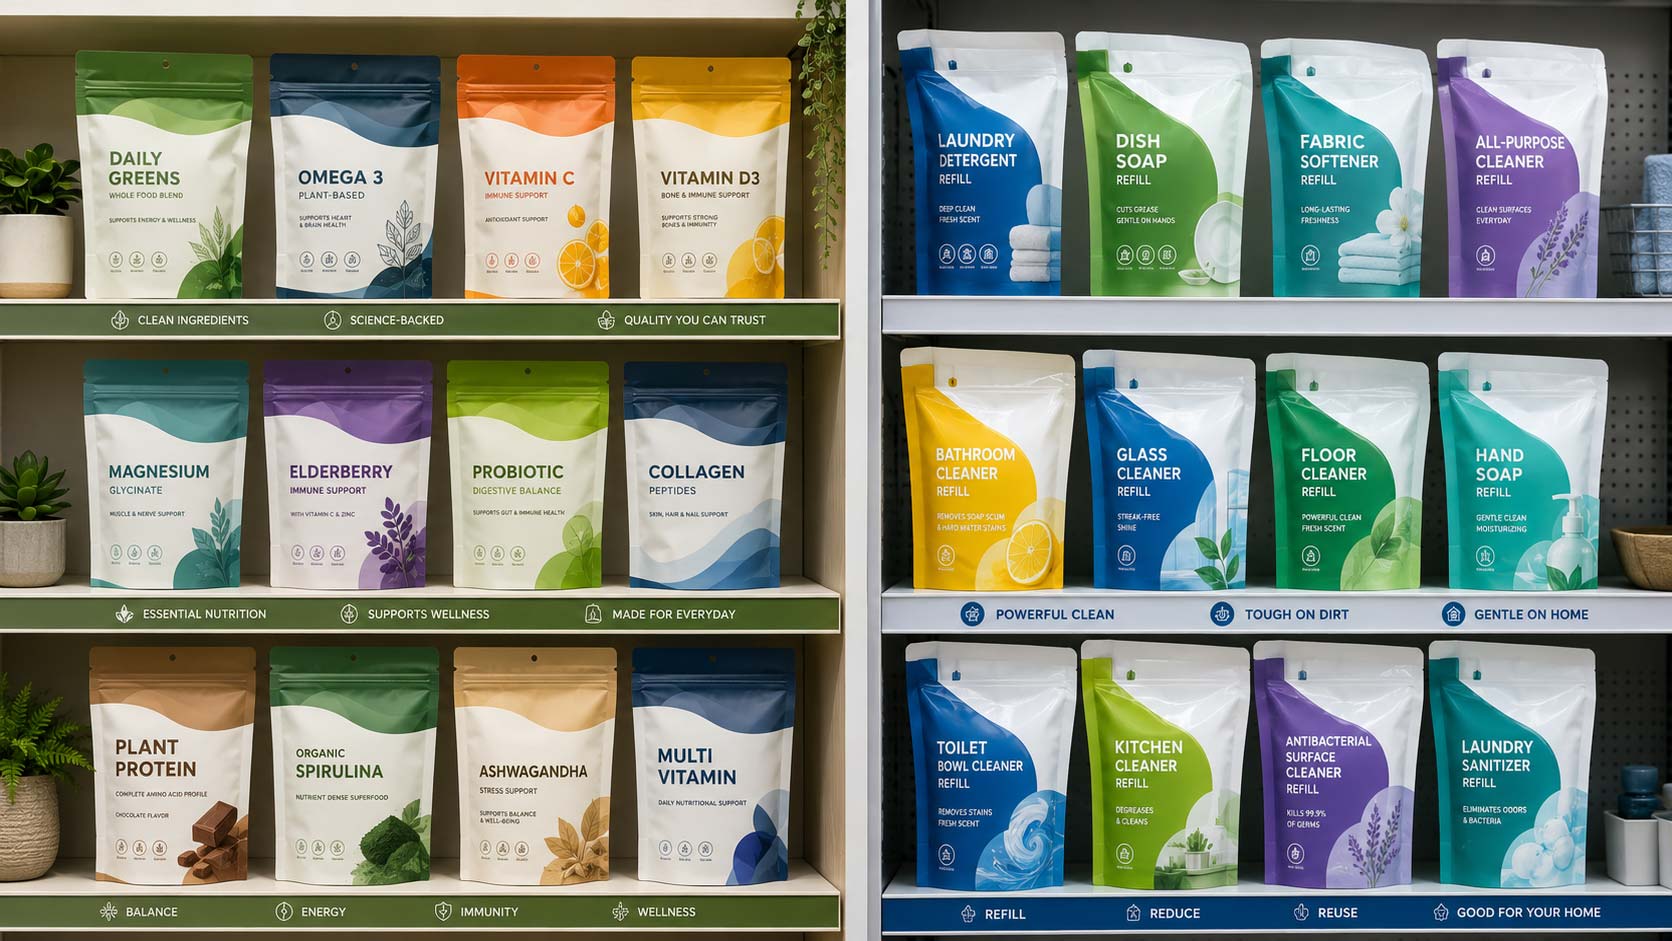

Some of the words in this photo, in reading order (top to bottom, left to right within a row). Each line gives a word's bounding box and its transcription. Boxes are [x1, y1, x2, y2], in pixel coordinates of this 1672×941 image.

[938, 133, 1016, 148] LAUNDRY
[1116, 133, 1160, 149] DISH
[1300, 134, 1365, 149] FABRIC
[1475, 135, 1566, 150] ALL-PURPOSE
[110, 151, 162, 166] DAILY
[939, 153, 1018, 167] DETERGENT
[1116, 153, 1167, 169] SOAP
[1300, 154, 1379, 169] SOFTENER
[1476, 154, 1544, 169] CLEANER
[108, 171, 180, 186] GREENS
[298, 170, 367, 185] OMEGA
[373, 170, 384, 185] 3
[484, 171, 557, 186] VITAMIN
[562, 171, 575, 186] C
[660, 171, 733, 186] VITAMIN
[739, 171, 760, 185] D3
[939, 173, 972, 185] REFILL
[1116, 174, 1152, 185] REFILL
[1301, 174, 1337, 185] REFILL
[1476, 174, 1513, 185] REFILL
[298, 191, 365, 200] PLANT-BASED
[484, 191, 514, 200] IMMUNE
[138, 315, 174, 325] CLEAN
[177, 315, 249, 325] INGREDIENTS
[350, 315, 444, 325] SCIENCE-BACKED
[624, 315, 673, 326] QUALITY
[675, 315, 699, 325] YOU
[702, 315, 727, 325] CAN
[730, 315, 766, 325] TRUST
[935, 447, 1016, 461] BATHROOM
[1117, 447, 1167, 462] GLASS
[1302, 448, 1356, 462] FLOOR
[1476, 448, 1524, 462] HAND
[109, 464, 209, 479] MAGNESIUM
[290, 465, 393, 479] ELDERBERRY
[473, 465, 564, 479] PROBIOTIC
[649, 465, 745, 479] COLLAGEN
[936, 466, 998, 480] CLEANER
[1117, 467, 1181, 480] CLEANER
[1301, 467, 1367, 481] CLEANER
[1476, 467, 1523, 481] SOAP
[109, 485, 163, 495] GLYCINATE
[290, 486, 324, 495] IMMUNE
[326, 486, 367, 495] SUPPORT
[472, 486, 517, 495] DIGESTIVE
[519, 486, 562, 495] BALANCE
[649, 486, 696, 495] PEPTIDES
[937, 485, 970, 497] REFILL
[1117, 486, 1151, 497] REFILL
[1302, 486, 1337, 497] REFILL
[1476, 487, 1512, 497] REFILL
[143, 609, 202, 619] ESSENTIAL
[205, 609, 266, 619] NUTRITION
[368, 609, 428, 620] SUPPORTS
[431, 609, 490, 620] WELLNESS
[612, 609, 646, 619] MADE
[649, 609, 673, 620] FOR
[676, 609, 736, 620] EVERYDAY
[996, 609, 1068, 620] POWERFUL
[1071, 609, 1114, 620] CLEAN
[1245, 609, 1291, 620] TOUGH
[1295, 609, 1315, 620] ON
[1319, 609, 1349, 620] DIRT
[1474, 609, 1524, 620] GENTLE
[1527, 609, 1547, 620] ON
[1551, 609, 1589, 620] HOME
[1285, 734, 1372, 747] ANTIBACTERIAL
[116, 739, 179, 755] PLANT
[296, 748, 345, 758] ORGANIC
[936, 740, 988, 755] TOILET
[1115, 740, 1183, 754] KITCHEN
[1462, 740, 1534, 754] LAUNDRY
[658, 748, 712, 763] MULTI
[1286, 751, 1336, 763] SURFACE
[116, 761, 196, 777] PROTEIN
[296, 764, 384, 779] SPIRULINA
[479, 765, 588, 778] ASHWAGANDHA
[938, 760, 969, 772] BOWL
[971, 760, 1023, 772] CLEANER
[1115, 759, 1177, 772] CLEANER
[1462, 759, 1531, 772] SANITIZER
[658, 769, 736, 785] VITAMIN
[1286, 766, 1342, 779] CLEANER
[938, 778, 970, 789] REFILL
[1115, 777, 1149, 789] REFILL
[1286, 783, 1319, 794] REFILL
[1462, 777, 1497, 788] REFILL
[479, 786, 504, 795] STRESS
[126, 907, 178, 917] BALANCE
[301, 907, 346, 917] ENERGY
[461, 907, 519, 917] IMMUNITY
[637, 907, 696, 917] WELLNESS
[985, 909, 1026, 920] REFILL
[1150, 908, 1201, 919] REDUCE
[1318, 907, 1358, 918] REUSE
[1457, 907, 1495, 918] GOOD
[1498, 907, 1523, 918] FOR
[1526, 907, 1561, 918] YOUR
[1564, 907, 1601, 918] HOME
